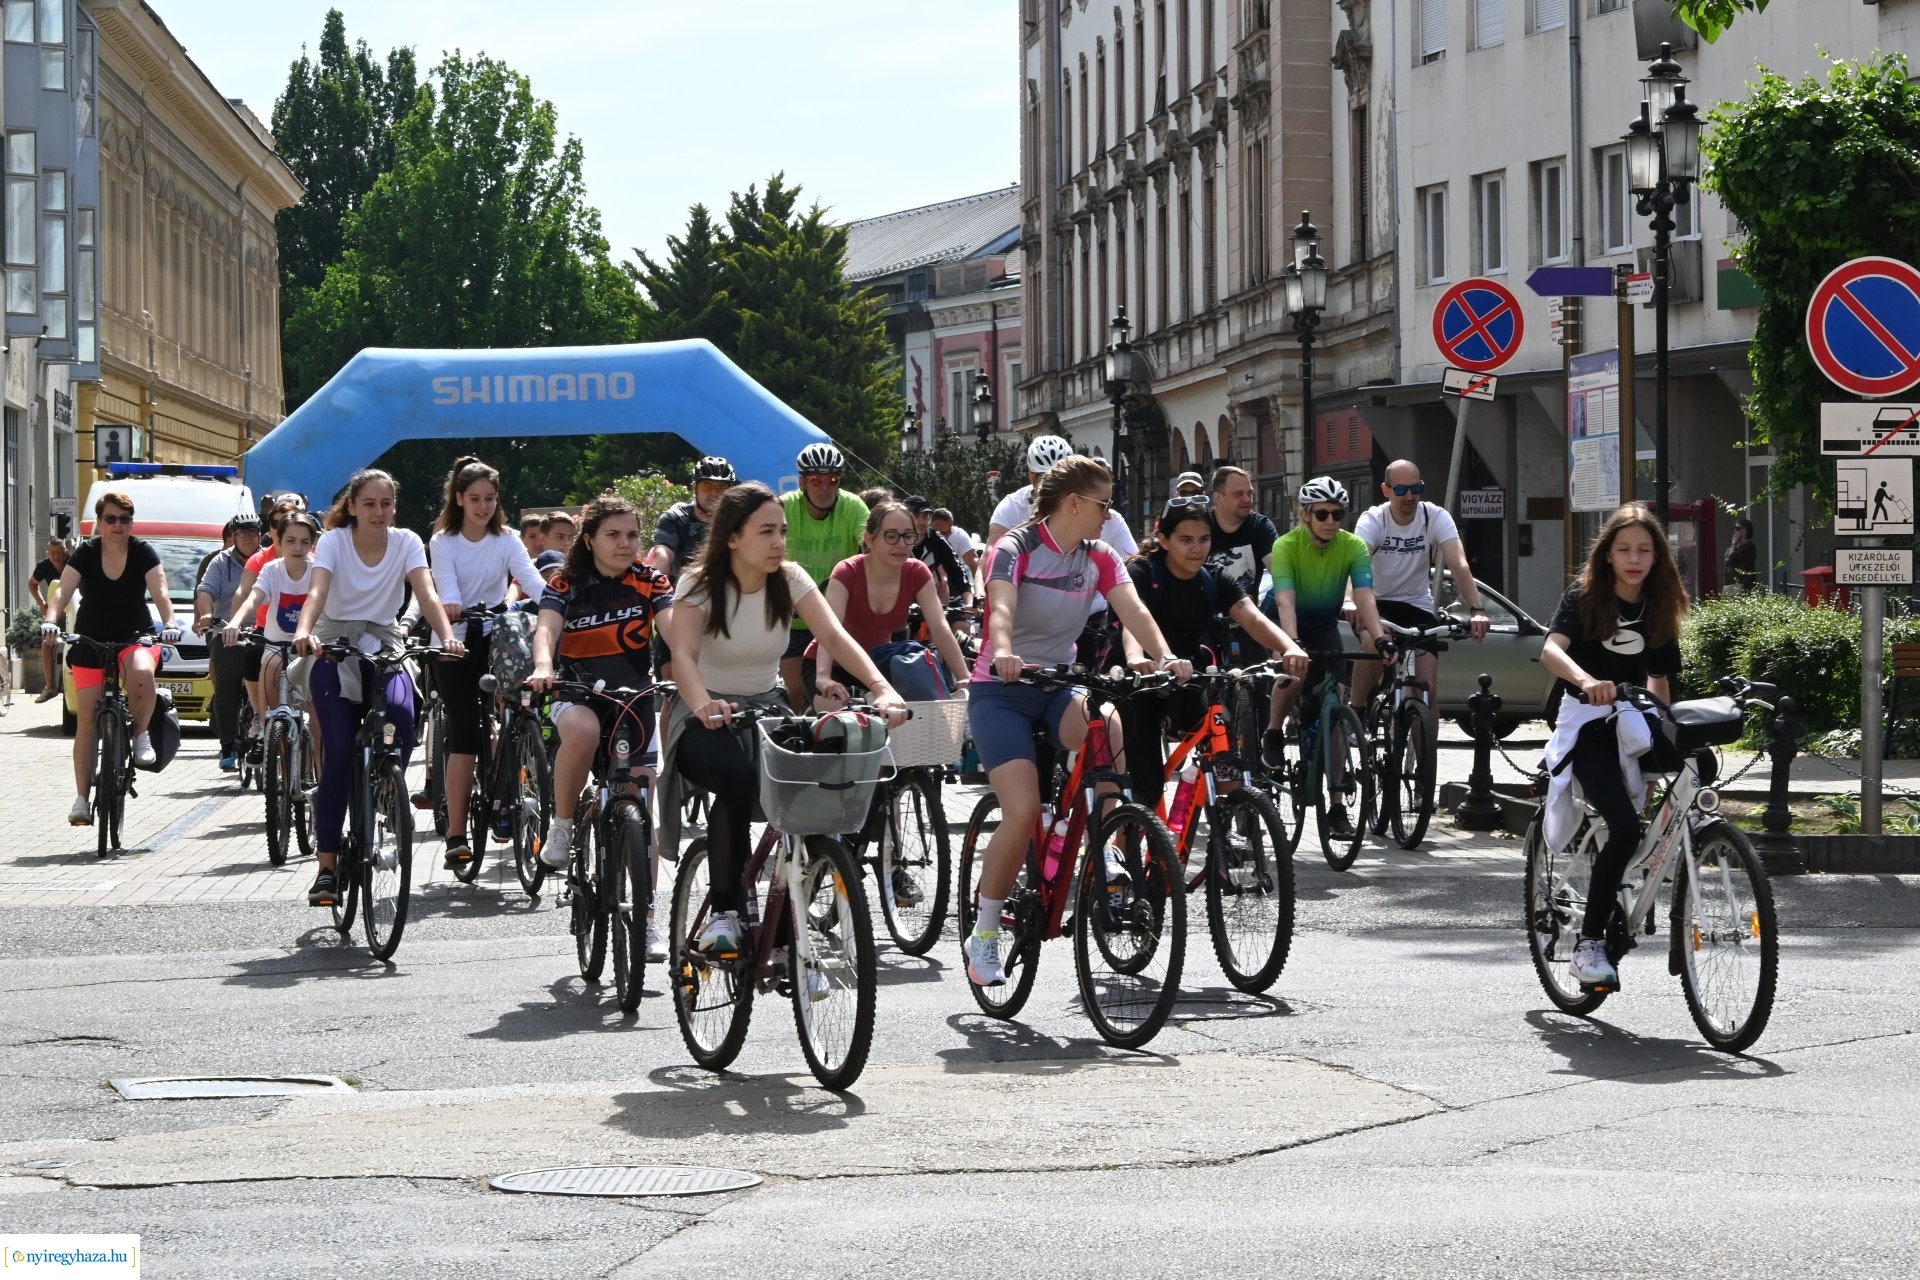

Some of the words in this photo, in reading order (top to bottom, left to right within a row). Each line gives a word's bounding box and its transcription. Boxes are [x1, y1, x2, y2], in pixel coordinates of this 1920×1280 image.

[432, 371, 635, 405] SHIMANO
[1461, 493, 1503, 504] VIGYÁZZ
[1848, 551, 1901, 561] KIZÁRÓLAG
[1849, 561, 1900, 571] ÚTKEZELŐI
[1842, 572, 1907, 582] ENGEDÉLLYEL
